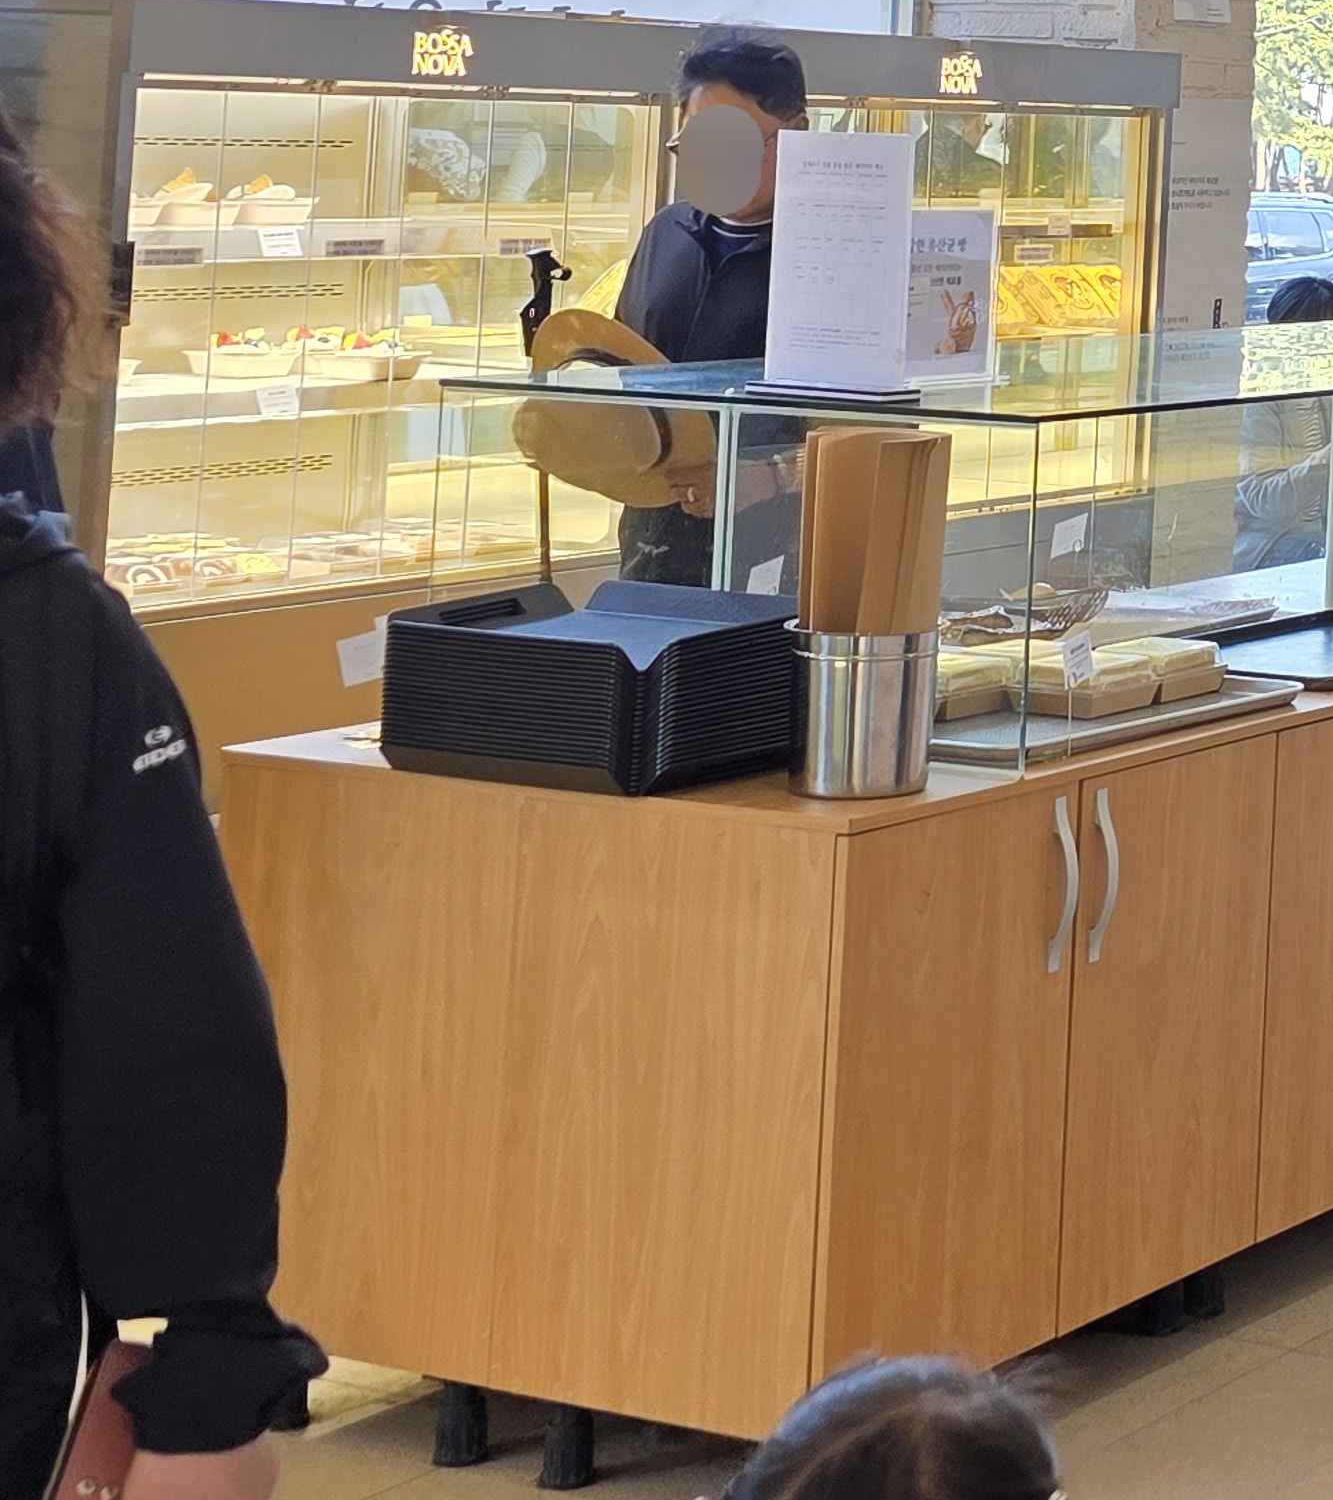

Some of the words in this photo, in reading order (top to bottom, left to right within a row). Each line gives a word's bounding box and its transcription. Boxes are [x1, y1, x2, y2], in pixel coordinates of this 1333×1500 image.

[413, 28, 475, 57] BOSSA
[411, 52, 467, 77] NOVA
[940, 54, 983, 77] BOSSA
[939, 74, 978, 95] NOVA
